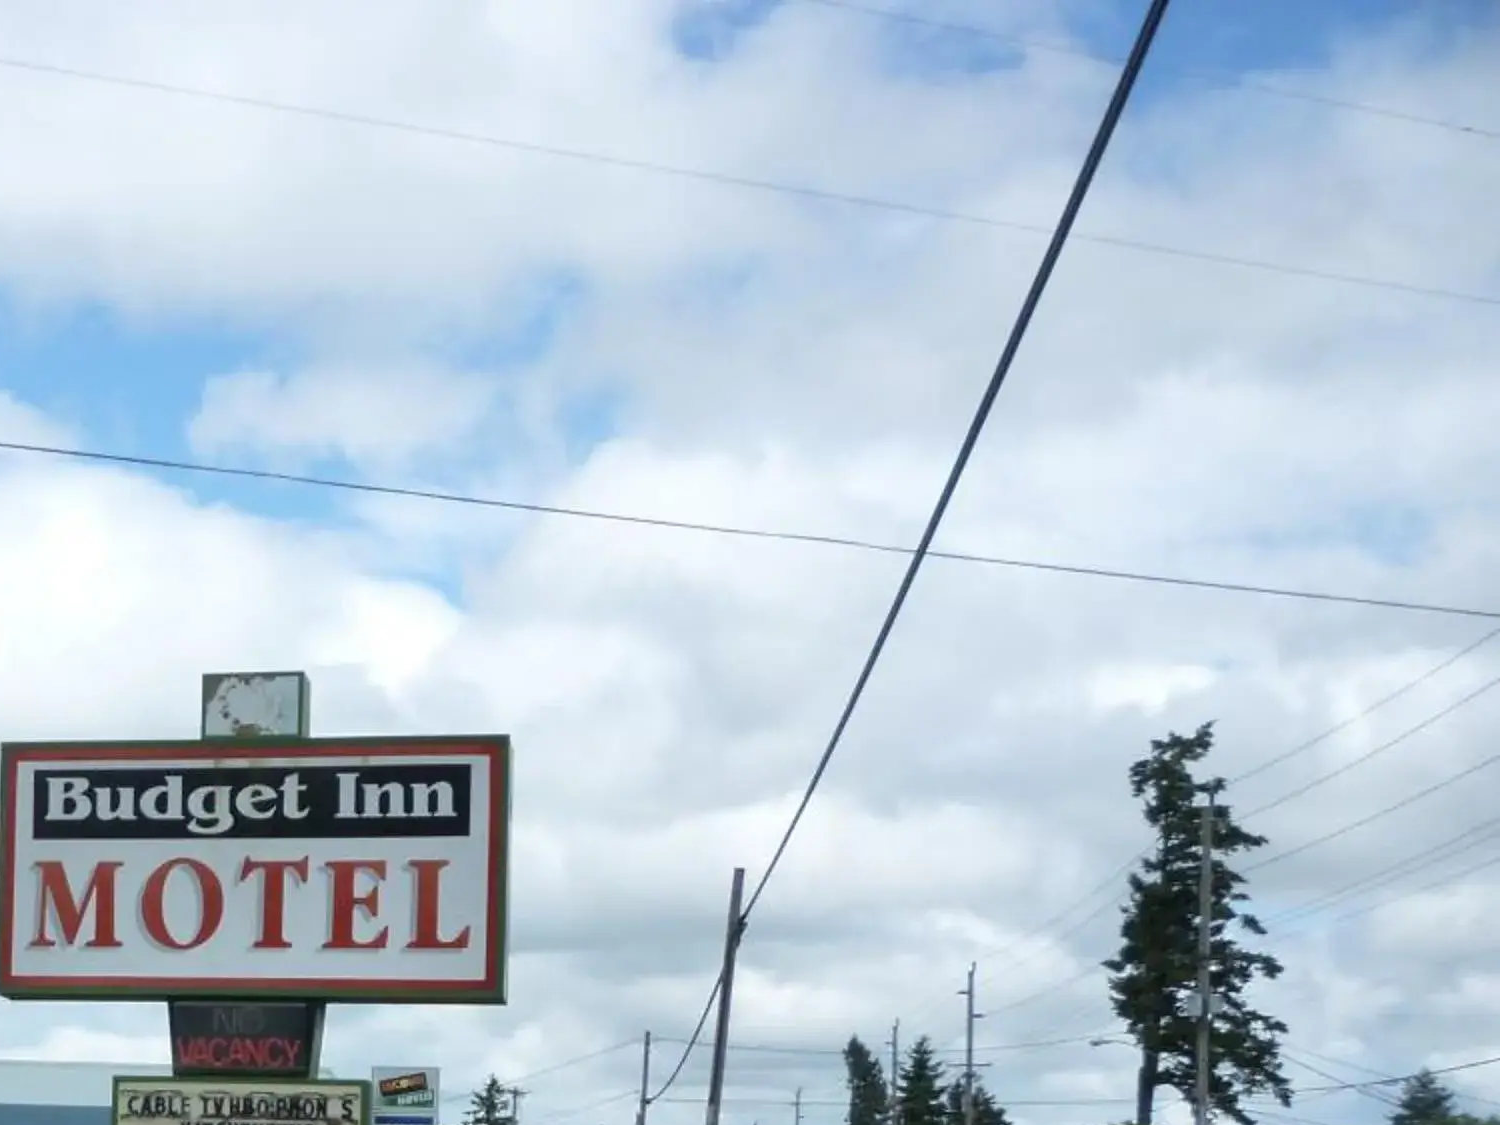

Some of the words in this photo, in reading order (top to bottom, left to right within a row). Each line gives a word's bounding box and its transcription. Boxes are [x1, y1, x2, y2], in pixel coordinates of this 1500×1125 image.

[44, 772, 311, 835] Budget
[333, 772, 459, 819] Inn
[27, 856, 472, 952] MOTEL
[212, 1006, 267, 1035] NO
[176, 1036, 301, 1068] VACANCY
[127, 1095, 191, 1118] CABLE
